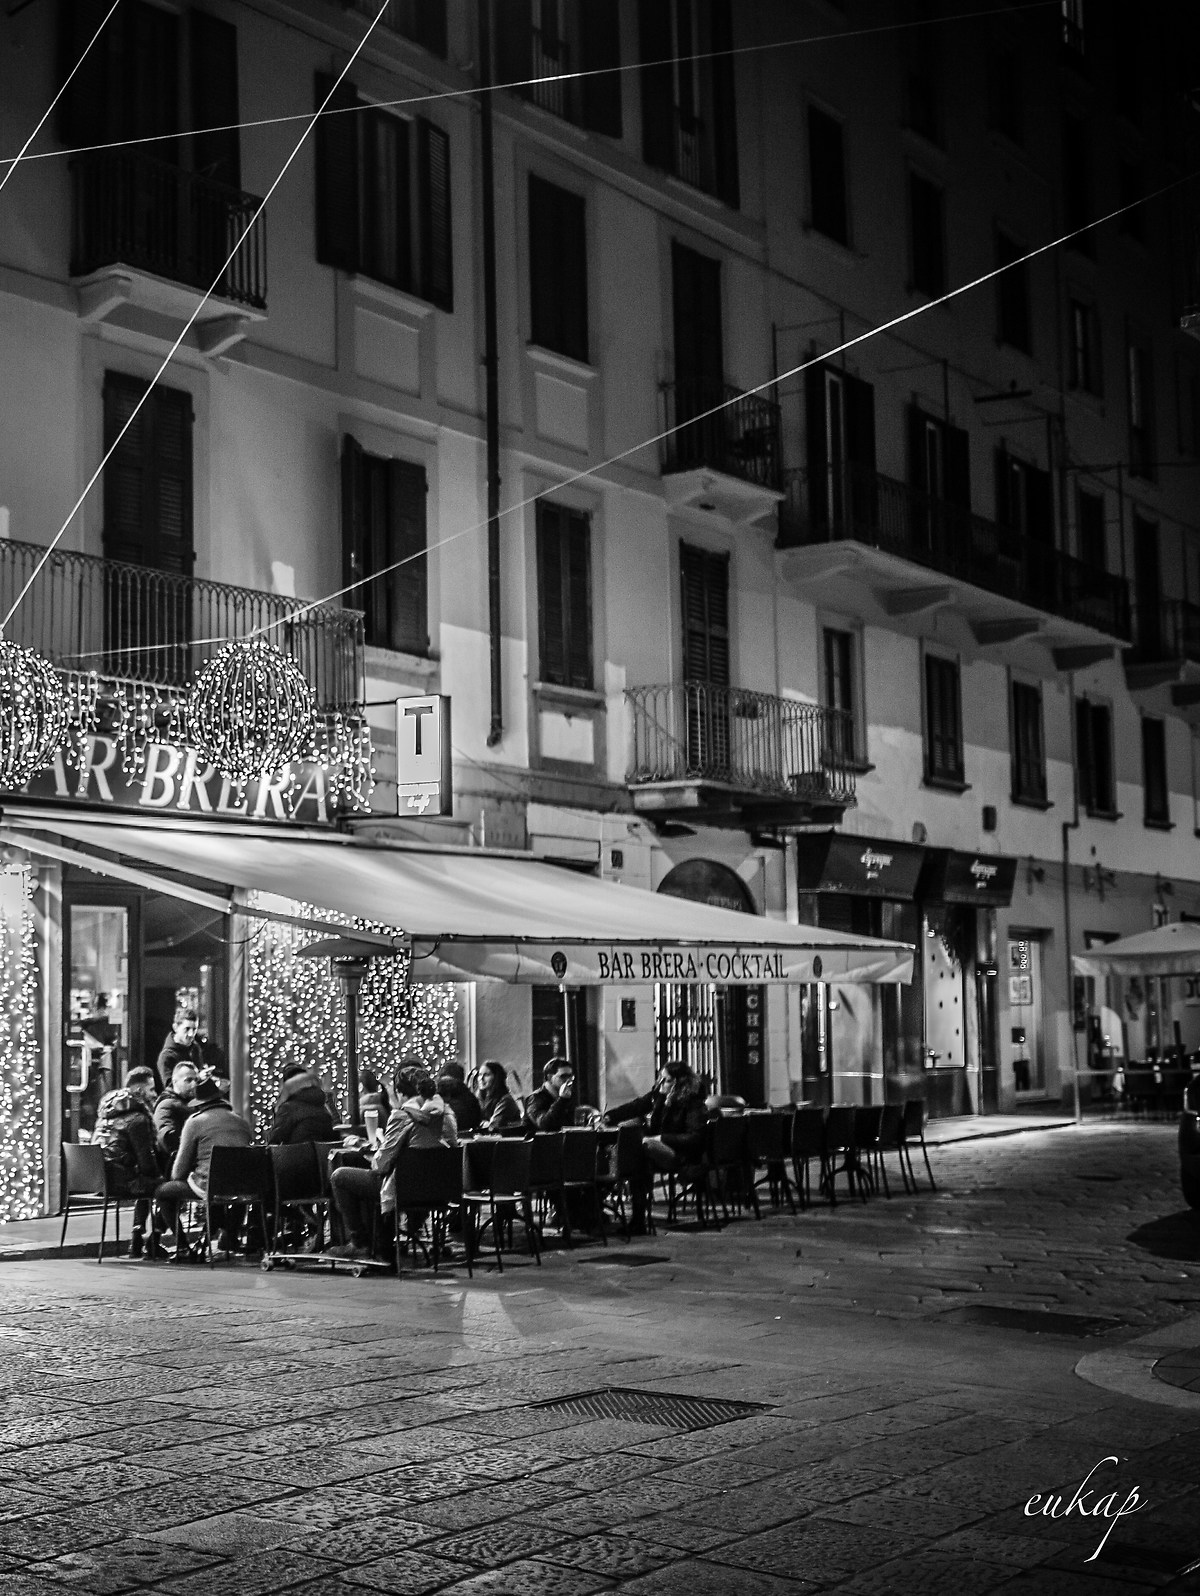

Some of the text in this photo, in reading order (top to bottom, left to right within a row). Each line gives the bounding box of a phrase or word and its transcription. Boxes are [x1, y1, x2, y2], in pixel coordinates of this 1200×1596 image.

[404, 706, 432, 755] T
[0, 734, 114, 801] AR
[598, 952, 789, 980] BAR BRERA COCKTAIL
